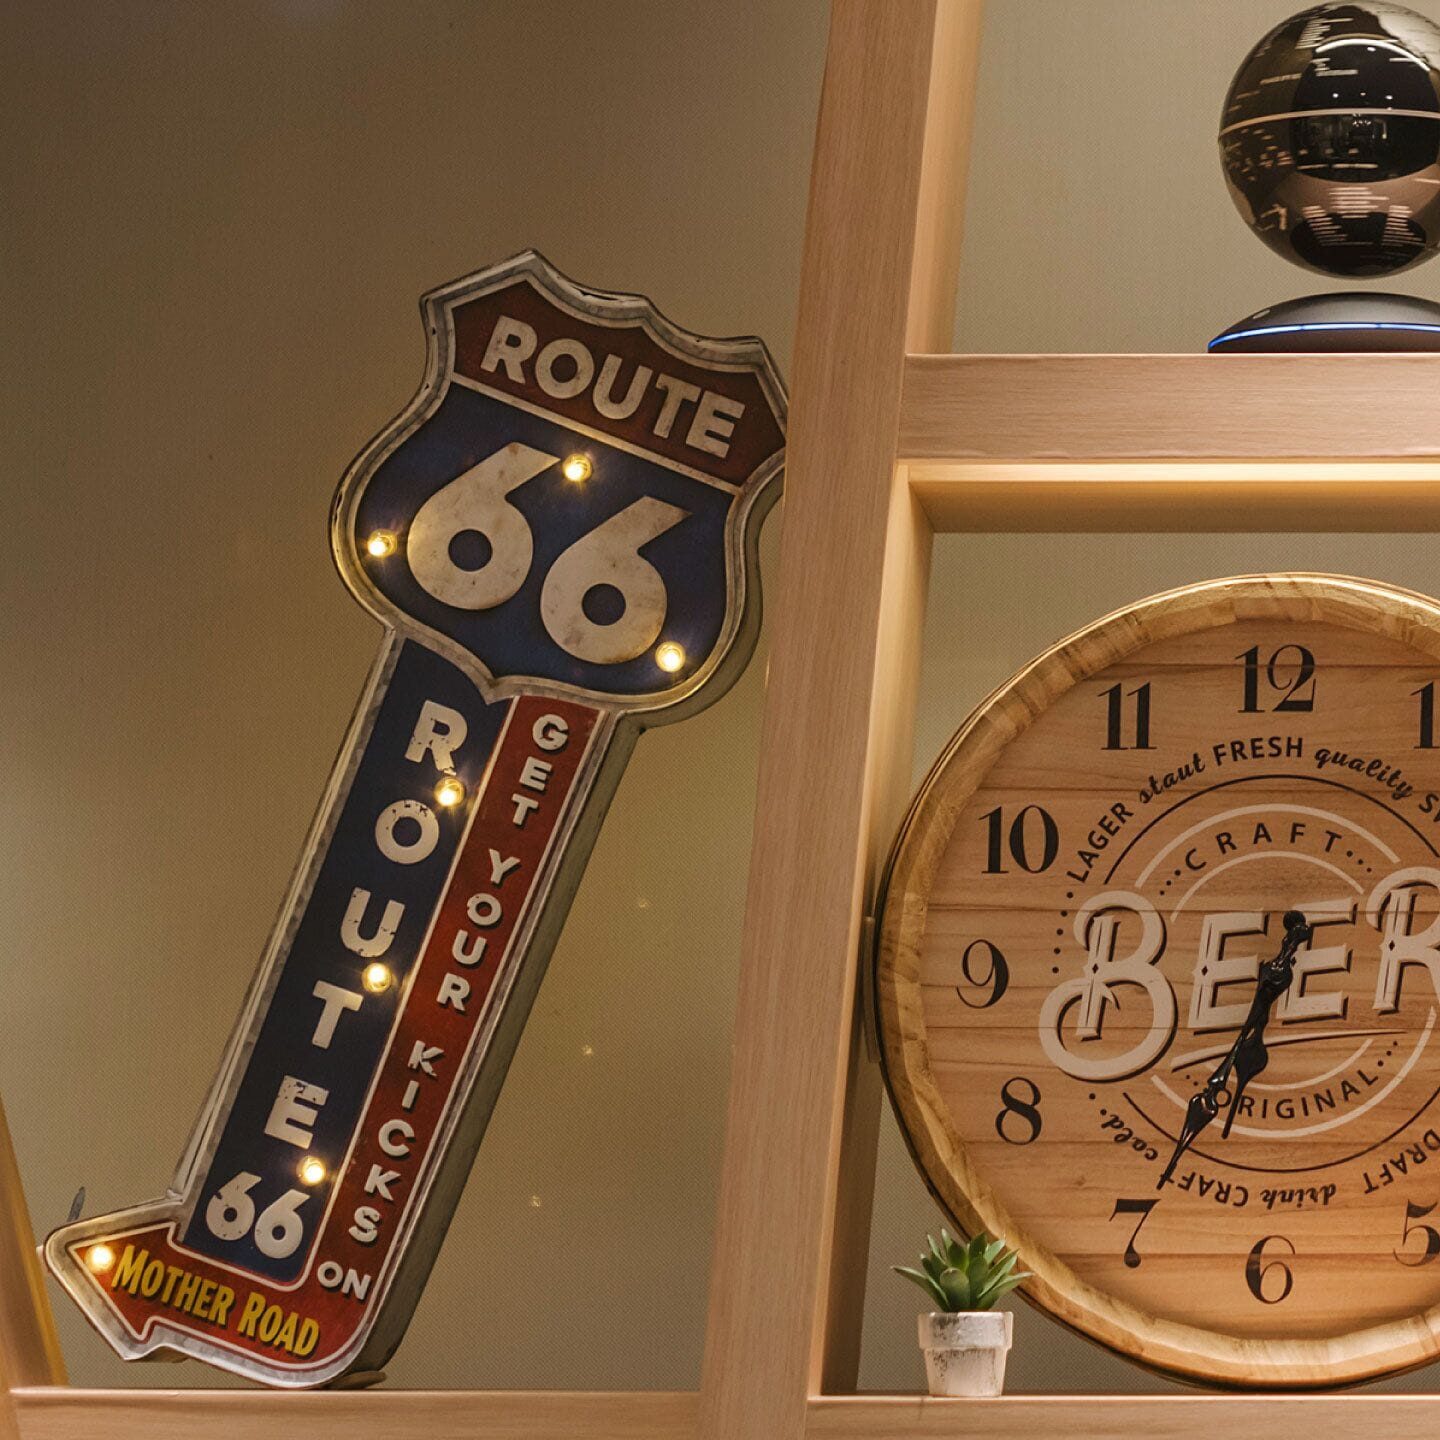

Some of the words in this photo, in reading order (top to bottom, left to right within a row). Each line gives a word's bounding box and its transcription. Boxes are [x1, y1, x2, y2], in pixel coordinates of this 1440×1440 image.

[480, 315, 745, 459] ROUTE
[406, 441, 693, 665] 66
[1097, 682, 1158, 750] 11
[1234, 644, 1317, 714] 12
[512, 713, 568, 826] GET
[978, 805, 1060, 875] 10
[1066, 802, 1134, 884] LAGER
[1212, 736, 1303, 767] FRESH
[1314, 747, 1413, 800] quality
[264, 700, 468, 1149] ROUTE
[436, 848, 520, 1012] YOUR
[956, 938, 1009, 1009] 9
[348, 1039, 445, 1244] KICKS
[995, 1077, 1043, 1146] 8
[206, 1171, 311, 1259] 66
[1108, 1199, 1162, 1269] 7
[1260, 1183, 1337, 1210] drink
[111, 1244, 235, 1326] MOTHER
[237, 1293, 320, 1357] ROAD
[317, 1261, 371, 1300] ON
[1245, 1235, 1296, 1305] 6
